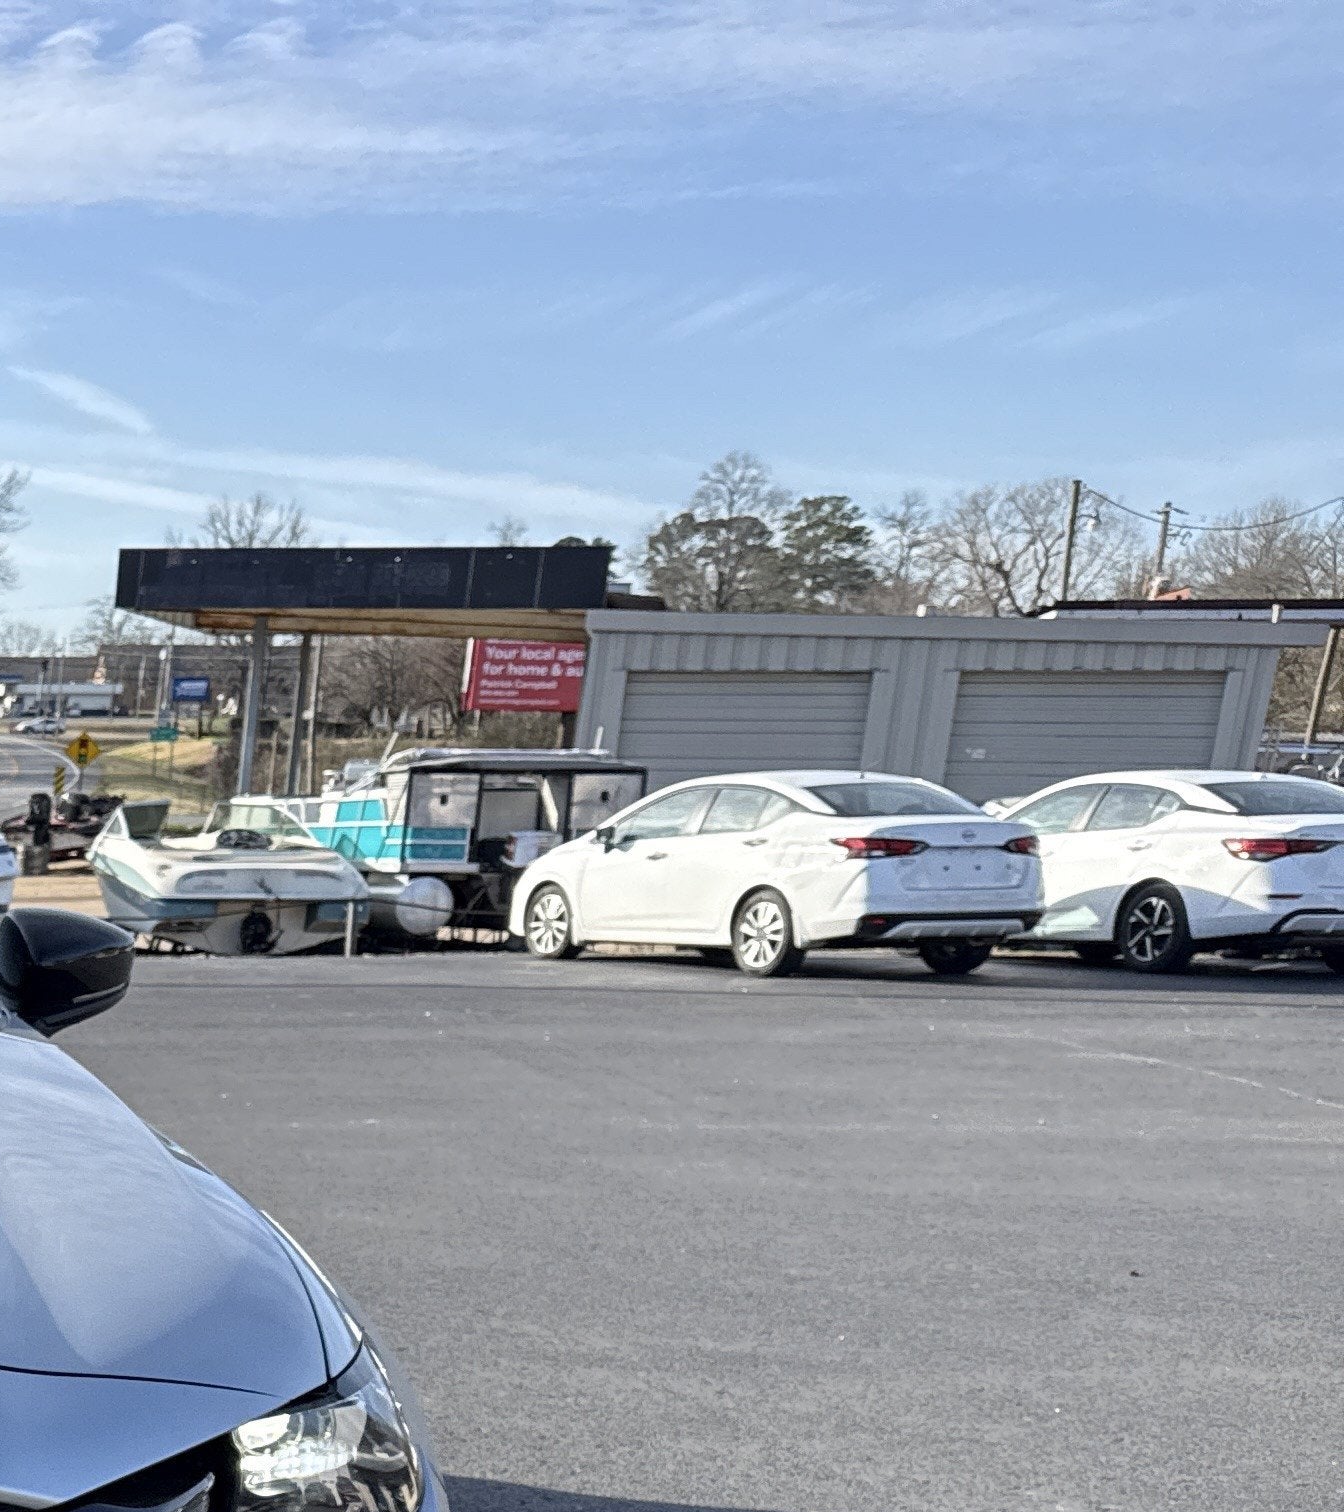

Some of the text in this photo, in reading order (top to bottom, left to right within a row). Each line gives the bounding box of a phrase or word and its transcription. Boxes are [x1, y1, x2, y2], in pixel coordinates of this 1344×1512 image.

[485, 646, 519, 660] Your
[521, 646, 556, 660] local
[482, 661, 506, 675] for
[506, 662, 549, 676] home
